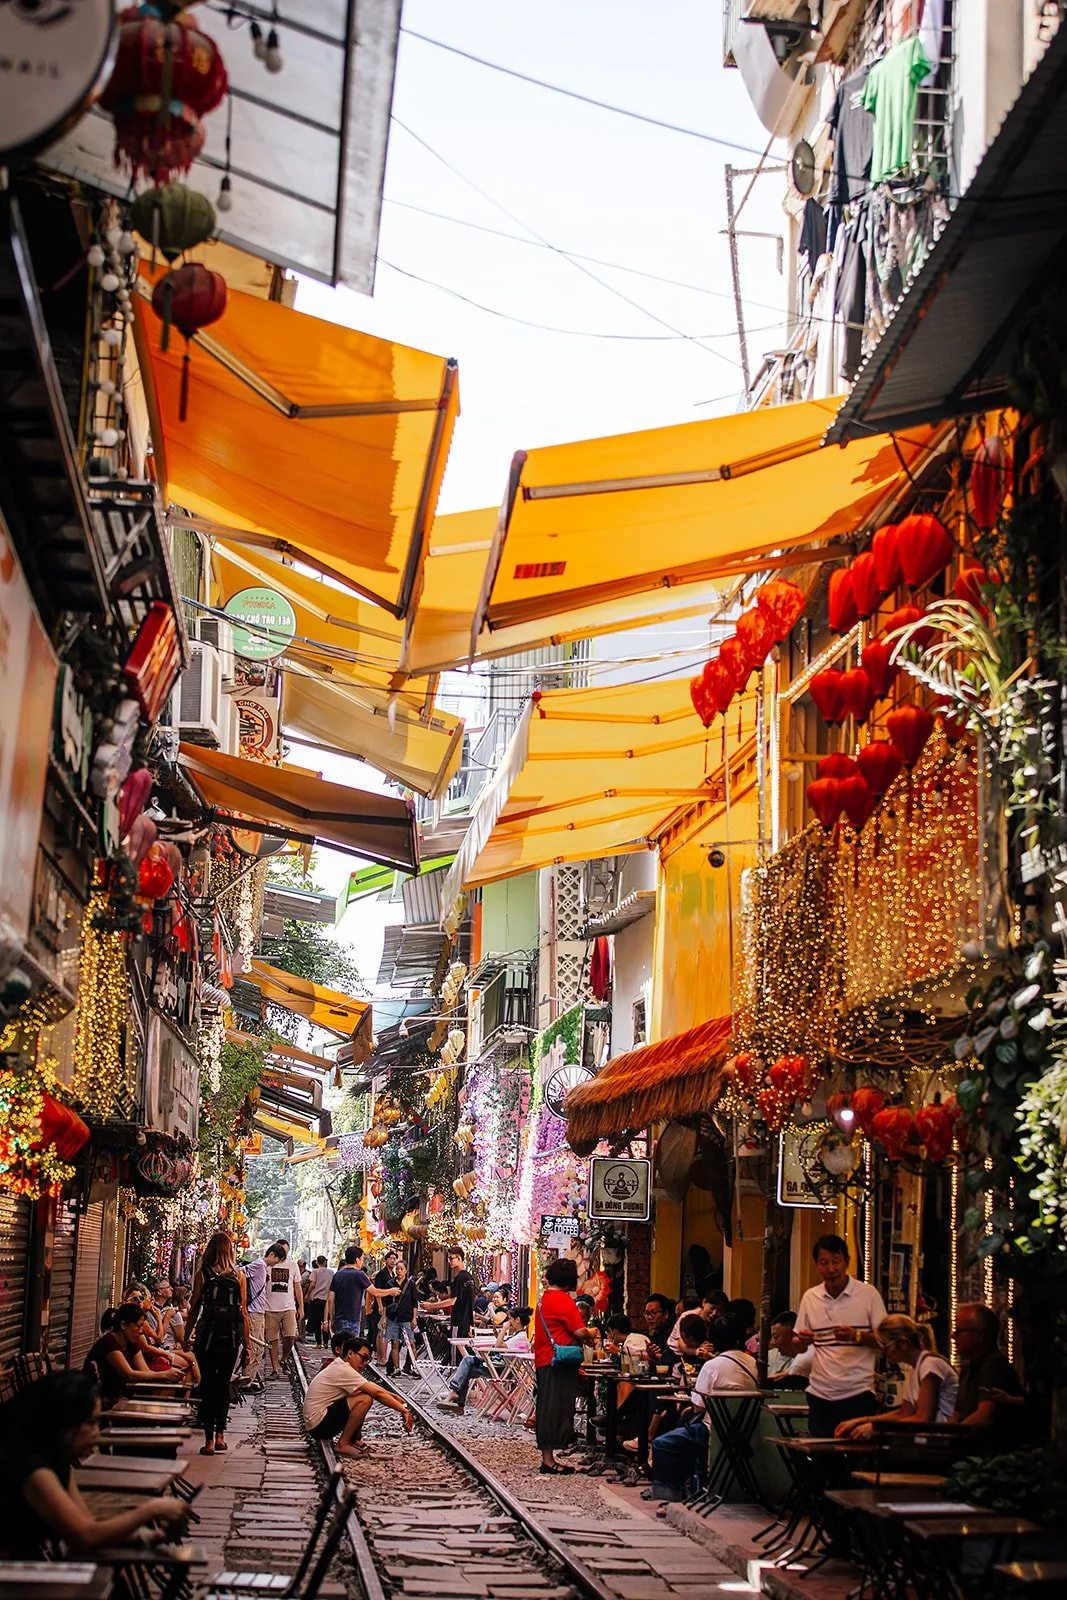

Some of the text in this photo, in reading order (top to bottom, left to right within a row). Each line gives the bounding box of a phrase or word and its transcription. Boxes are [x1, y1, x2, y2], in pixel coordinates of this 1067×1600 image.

[786, 1181, 798, 1193] GA
[595, 1201, 604, 1209] GA
[554, 1224, 579, 1238] COFFEE
